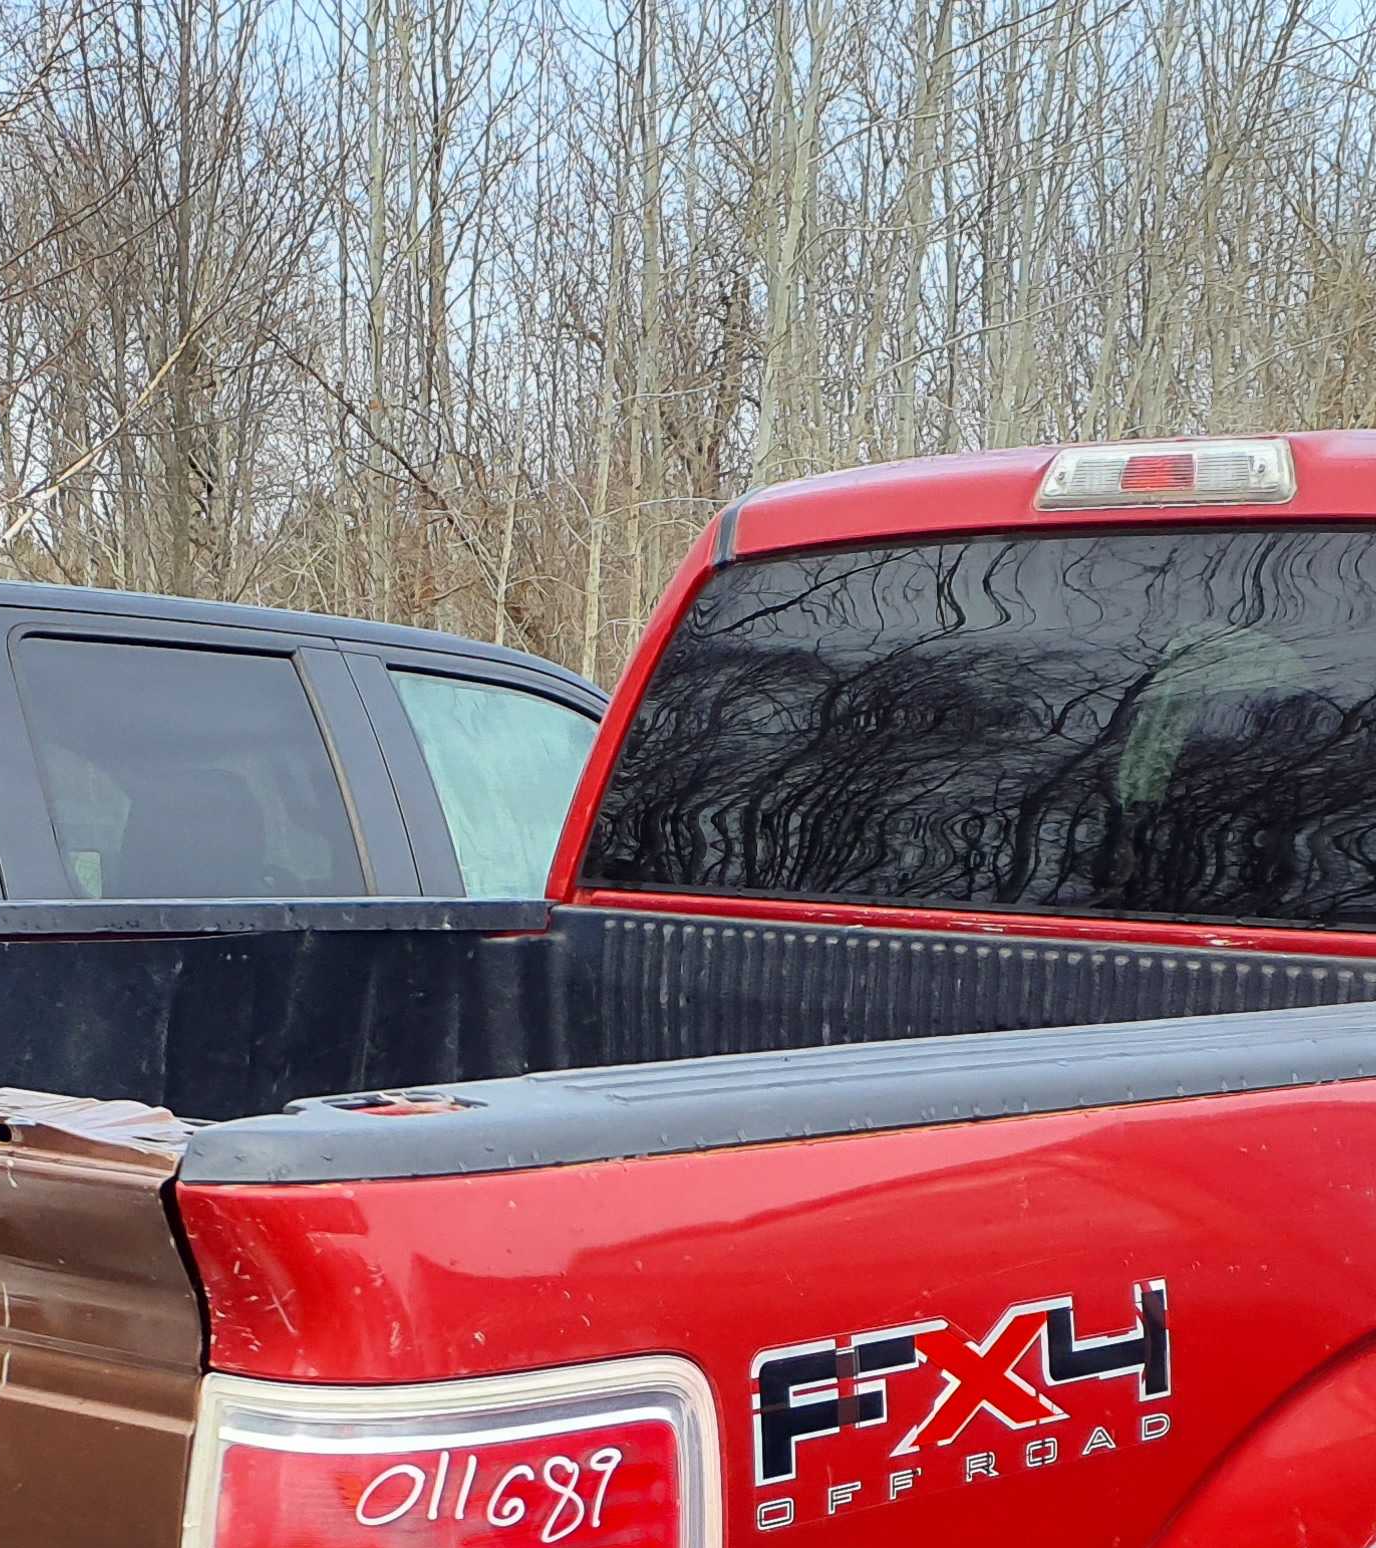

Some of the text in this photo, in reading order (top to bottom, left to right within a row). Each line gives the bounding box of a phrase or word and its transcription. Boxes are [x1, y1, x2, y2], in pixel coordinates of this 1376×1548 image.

[749, 1276, 1172, 1488] FX4
[355, 1446, 623, 1544] 011689
[755, 1412, 1172, 1531] OFF ROAD
